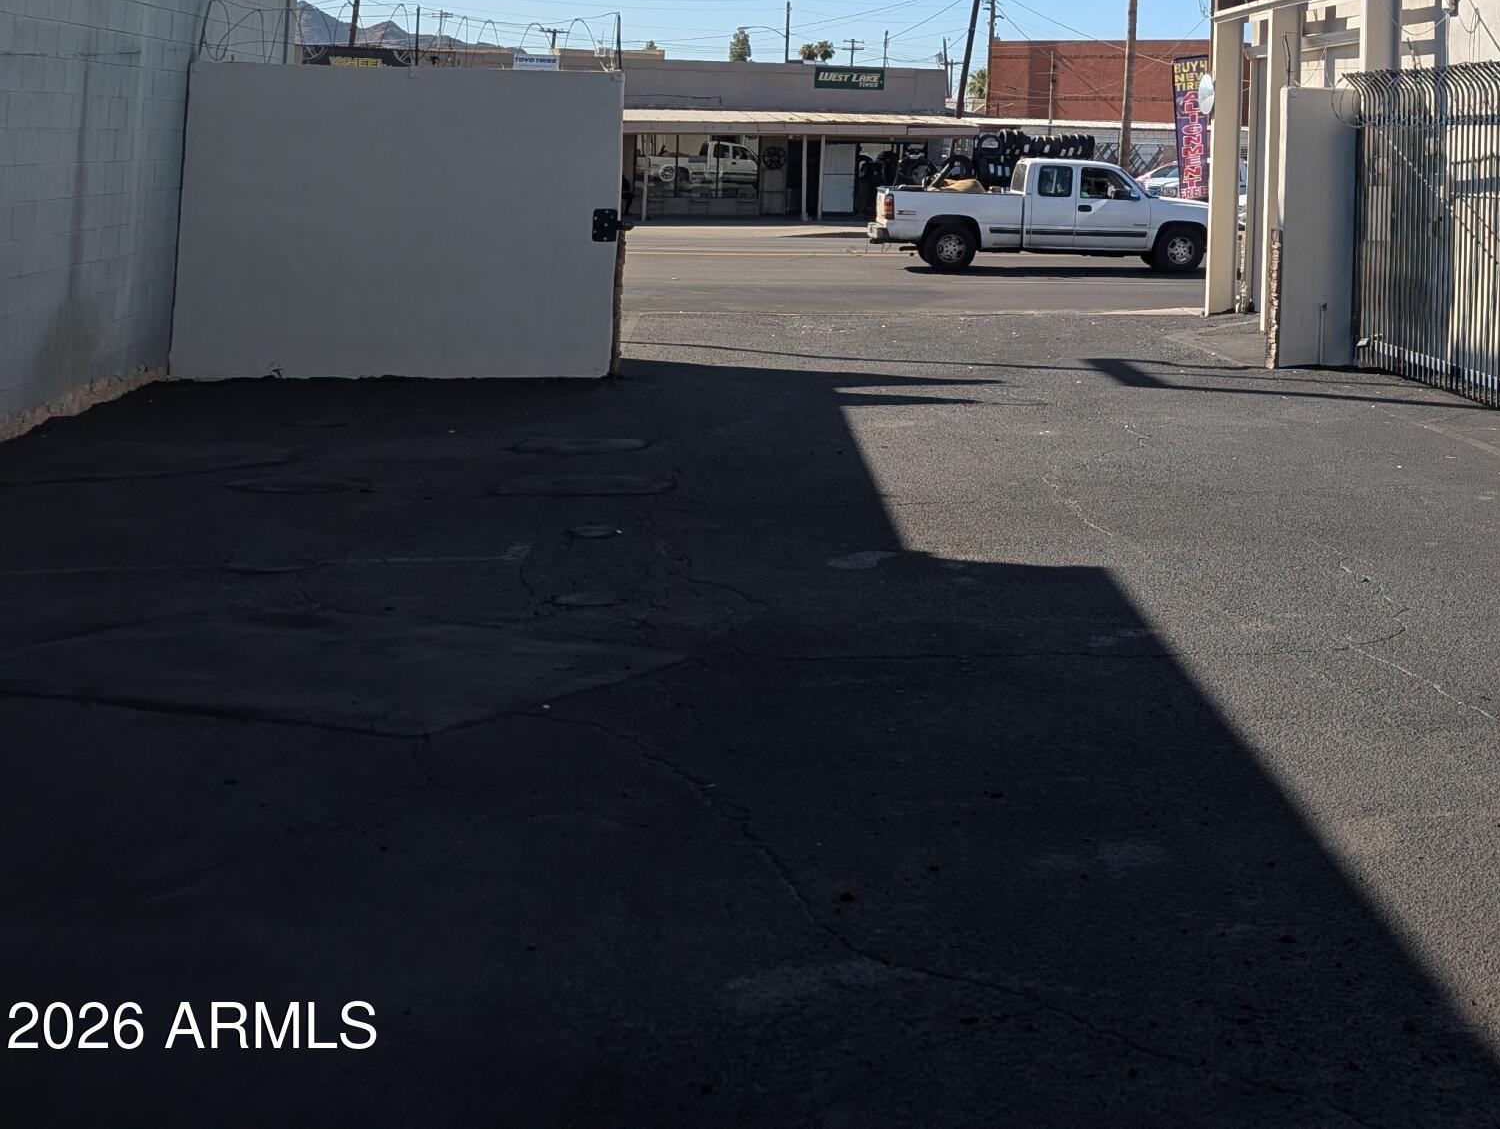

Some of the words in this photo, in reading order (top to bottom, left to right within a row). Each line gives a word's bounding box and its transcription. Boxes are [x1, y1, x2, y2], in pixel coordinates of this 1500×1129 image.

[328, 55, 384, 68] WHEEL
[1174, 61, 1198, 74] BUY
[1199, 60, 1208, 72] 4
[1179, 186, 1209, 199] FREE
